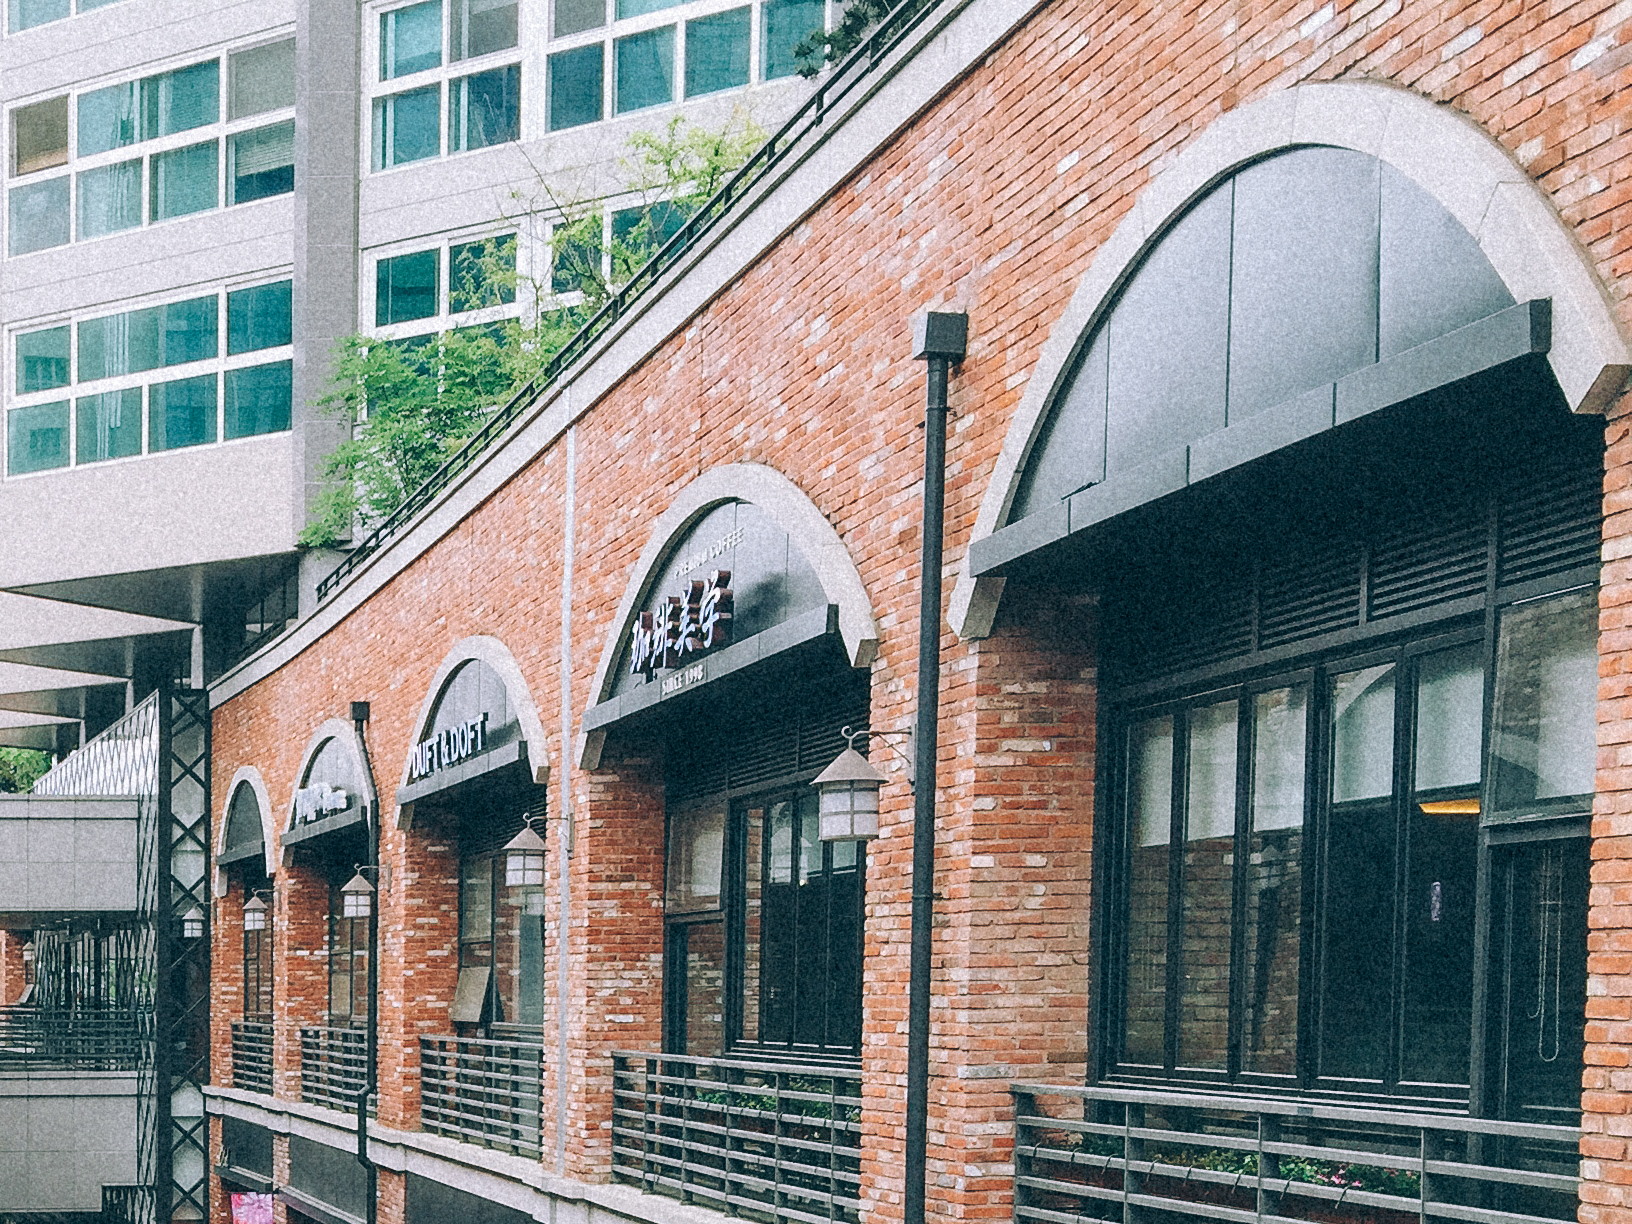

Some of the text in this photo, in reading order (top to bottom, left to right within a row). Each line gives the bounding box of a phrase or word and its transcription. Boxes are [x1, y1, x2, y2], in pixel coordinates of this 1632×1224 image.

[710, 527, 745, 558] COFFEE
[412, 713, 484, 779] DUFT & DOFT
